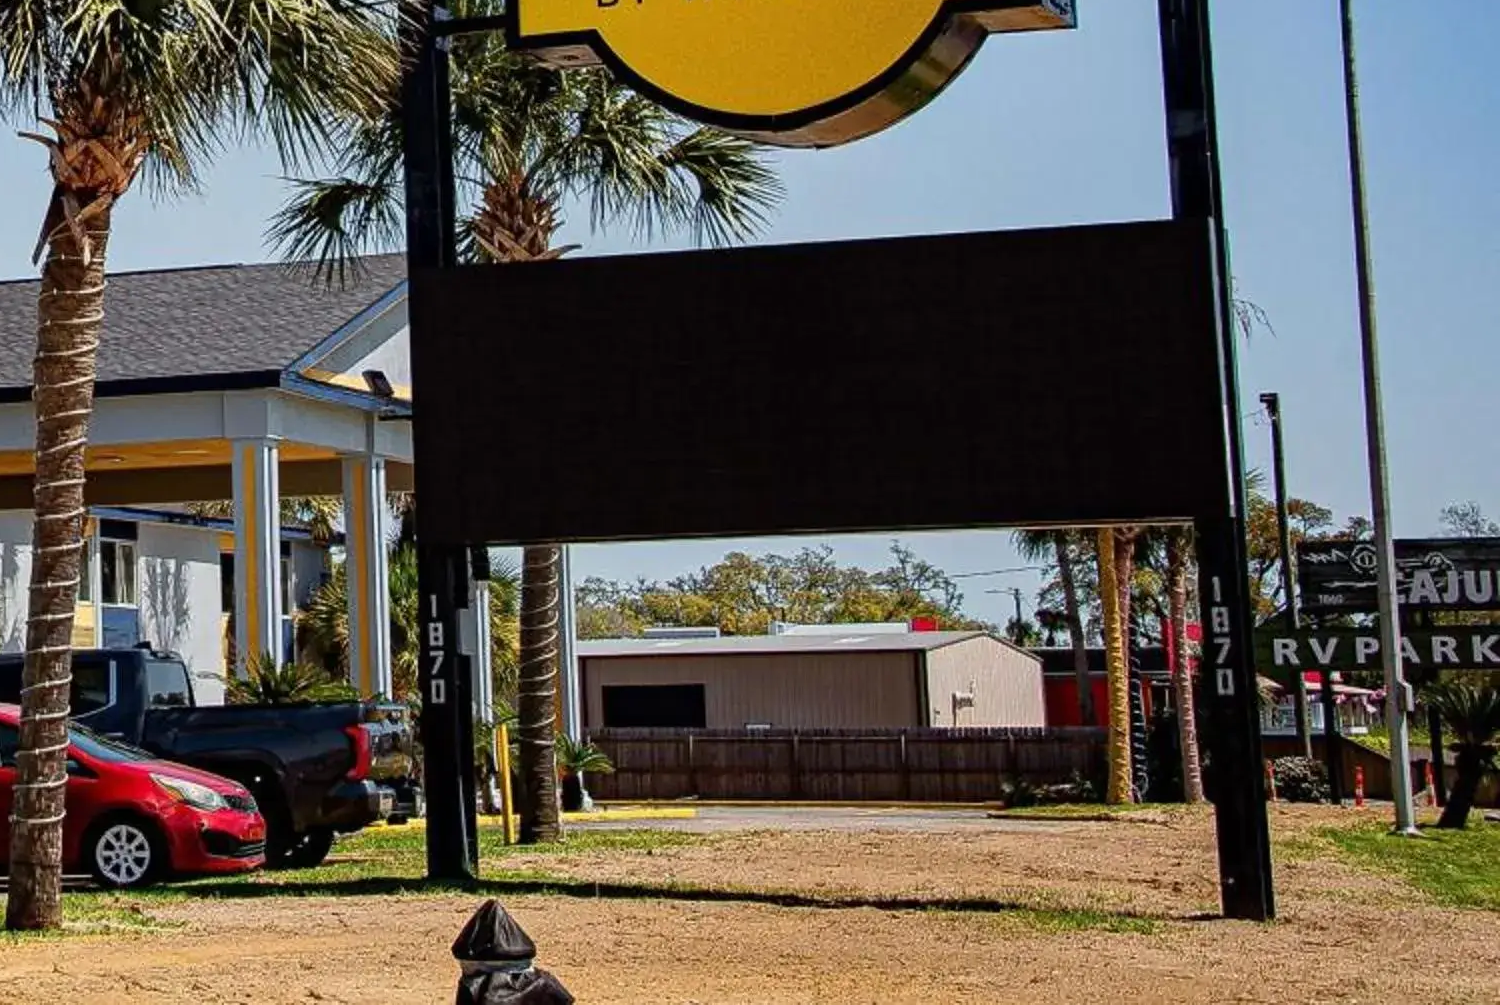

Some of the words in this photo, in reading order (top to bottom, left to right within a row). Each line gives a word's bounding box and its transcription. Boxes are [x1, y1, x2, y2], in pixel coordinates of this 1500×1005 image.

[1395, 569, 1500, 605] AJU
[428, 594, 446, 704] 1870
[1211, 576, 1235, 696] 1870
[1273, 636, 1338, 666] RV
[1355, 634, 1500, 665] PARK
